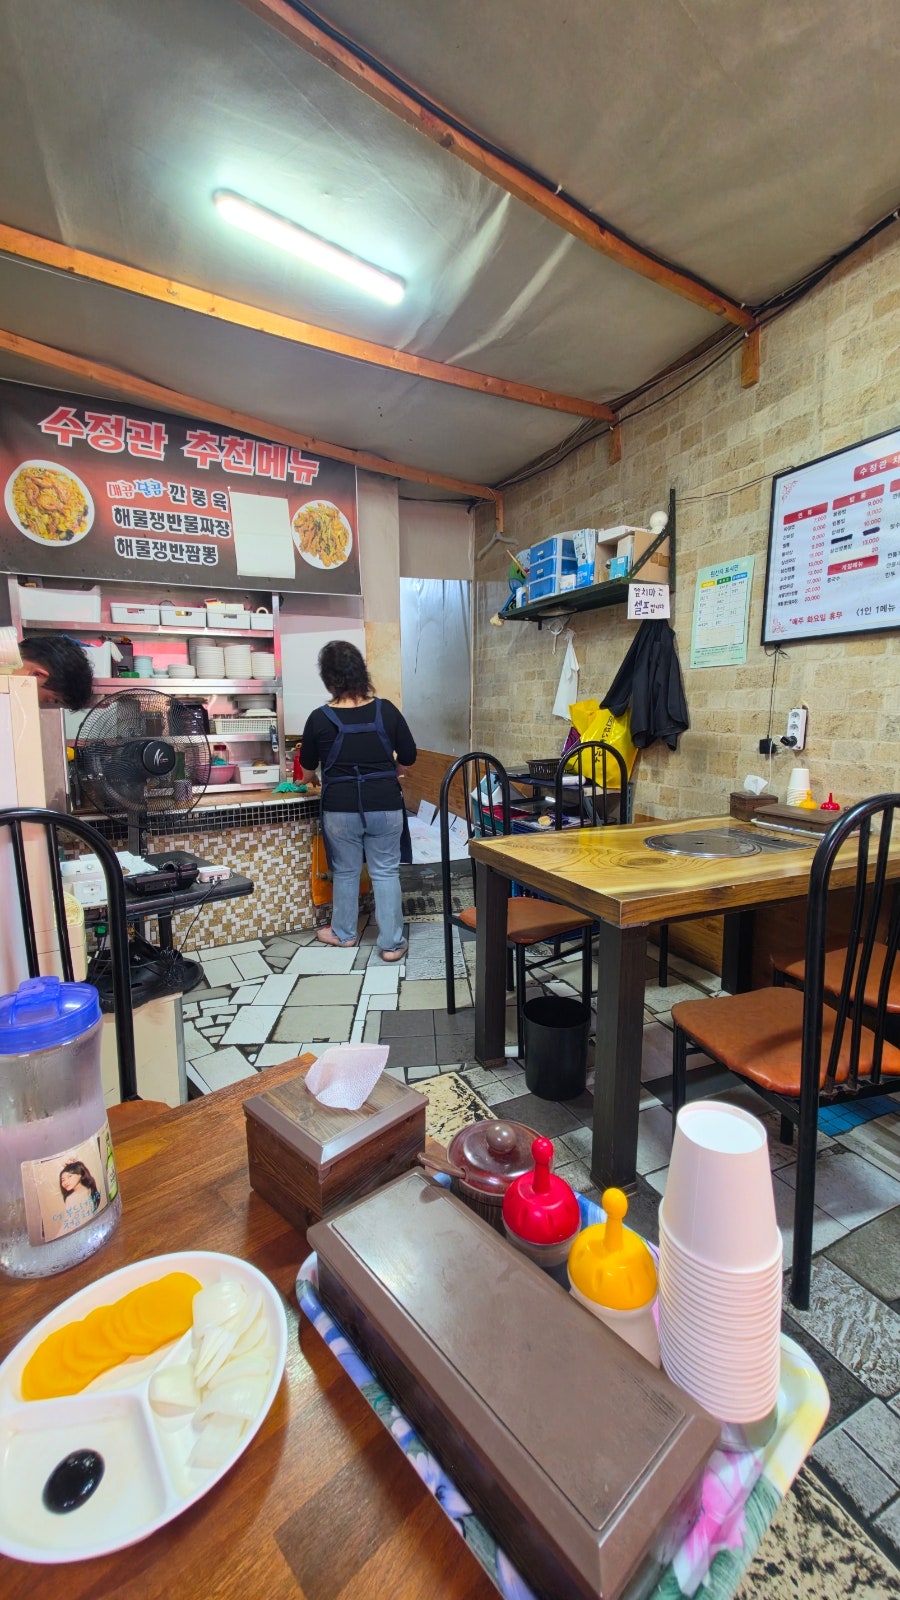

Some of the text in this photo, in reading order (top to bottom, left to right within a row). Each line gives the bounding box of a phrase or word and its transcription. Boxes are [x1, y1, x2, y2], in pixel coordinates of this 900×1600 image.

[41, 406, 320, 485] 수정관 추천메뉴
[113, 506, 231, 538] 해물쟁반물짜장
[115, 537, 217, 565] 해물쟁반짬뽕
[634, 587, 656, 598] 앞치마
[634, 599, 650, 616] 셀프
[806, 613, 826, 624] 화요일
[829, 611, 843, 621] 휴무
[875, 603, 896, 614] 1메뉴
